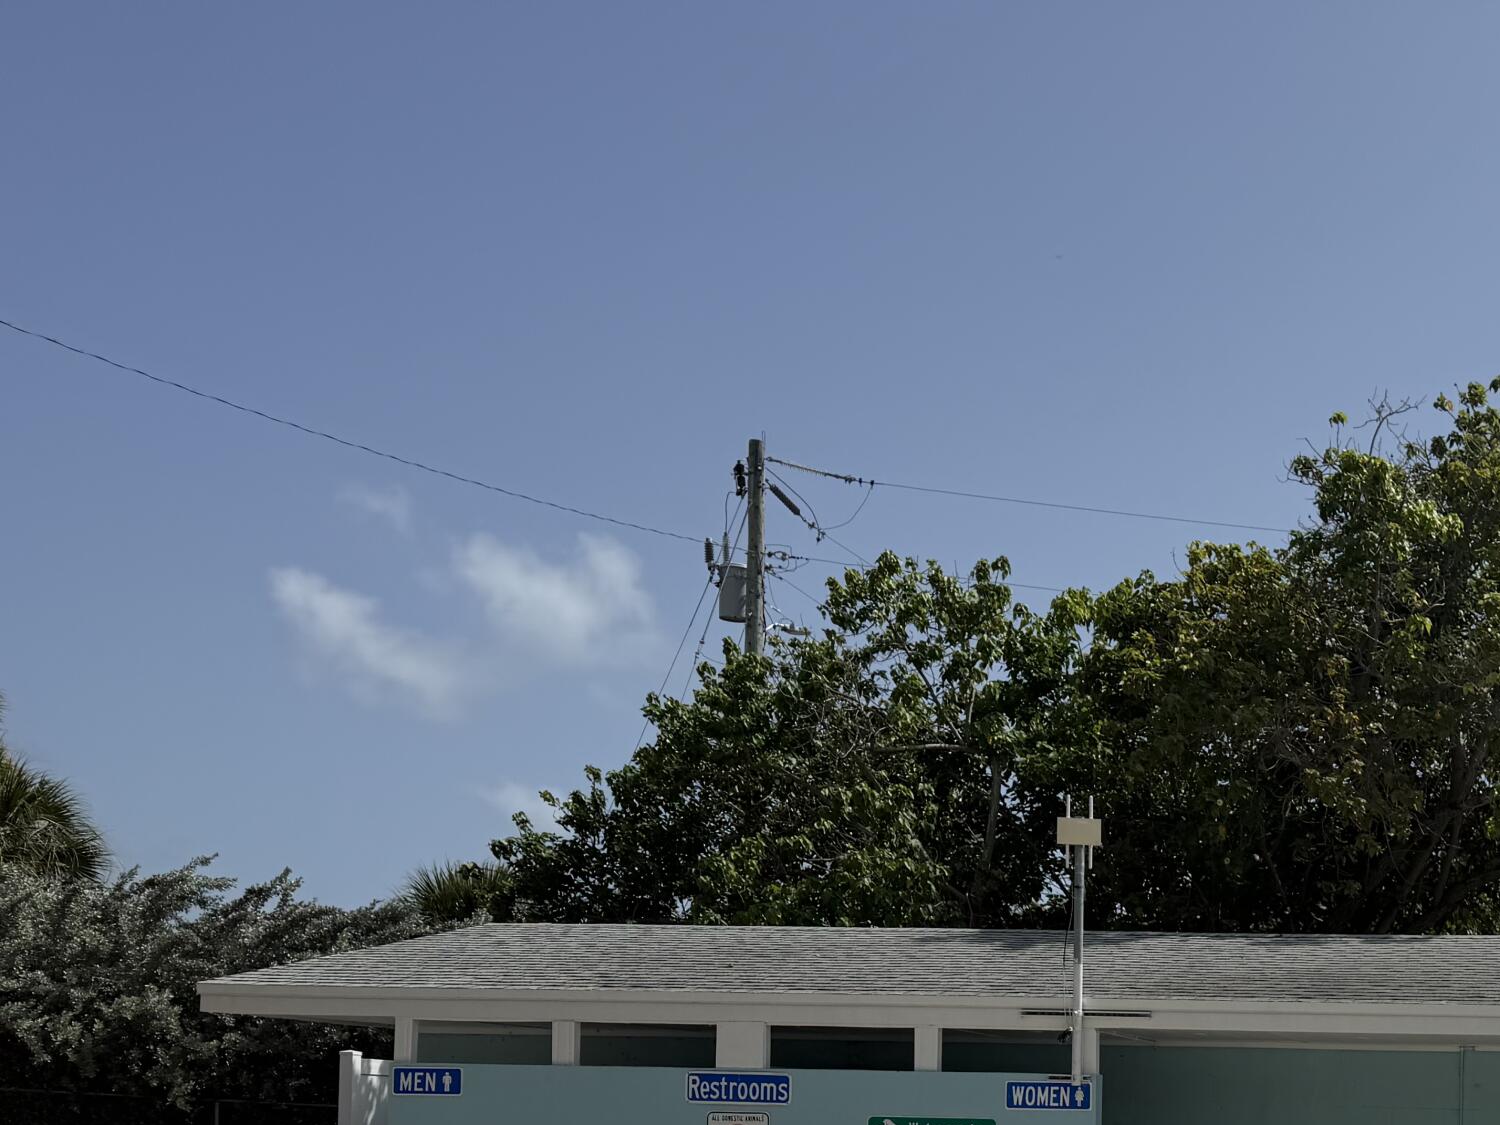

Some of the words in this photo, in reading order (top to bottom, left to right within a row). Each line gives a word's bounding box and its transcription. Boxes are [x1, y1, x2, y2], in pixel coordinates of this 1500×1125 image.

[400, 1071, 437, 1092] MEN
[689, 1075, 788, 1101] Restrooms
[1012, 1085, 1070, 1107] WOMEN
